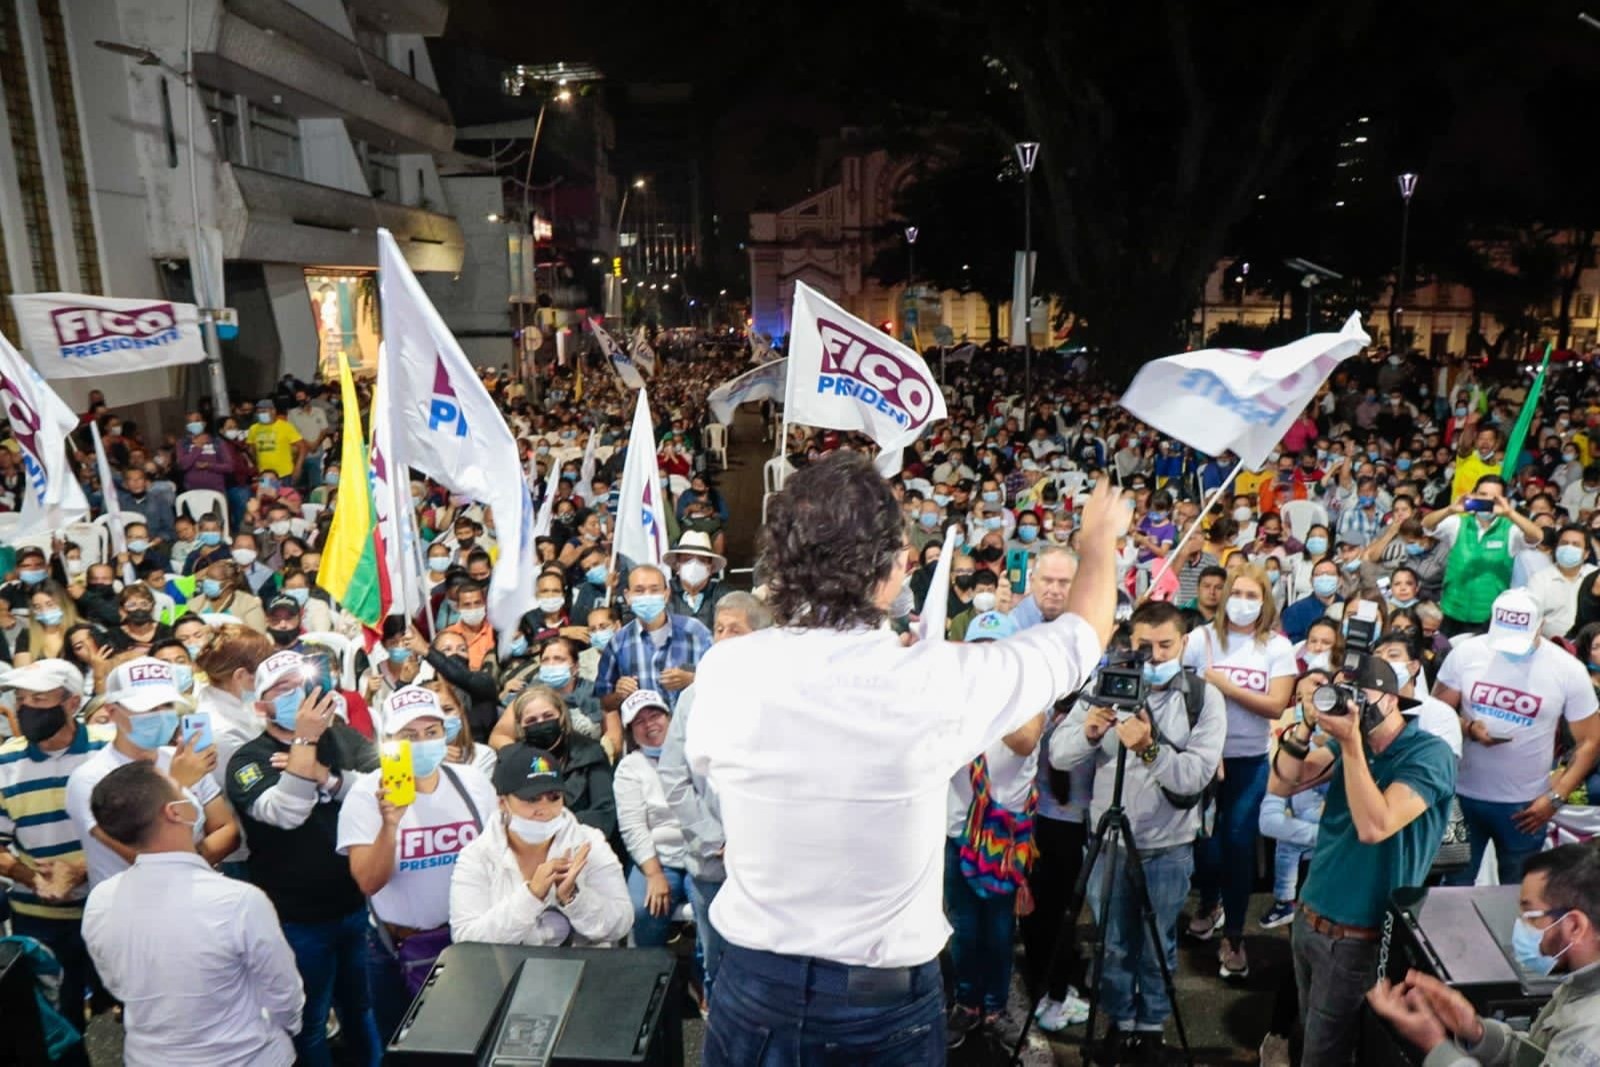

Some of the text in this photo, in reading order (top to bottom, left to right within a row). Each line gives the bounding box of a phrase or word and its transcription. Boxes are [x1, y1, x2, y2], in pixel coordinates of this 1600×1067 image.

[53, 309, 174, 344] FICO
[820, 324, 930, 423] FICO
[1496, 609, 1529, 624] FICO
[392, 690, 434, 709] FICO
[1472, 683, 1538, 715] FICO
[404, 823, 478, 858] FICO
